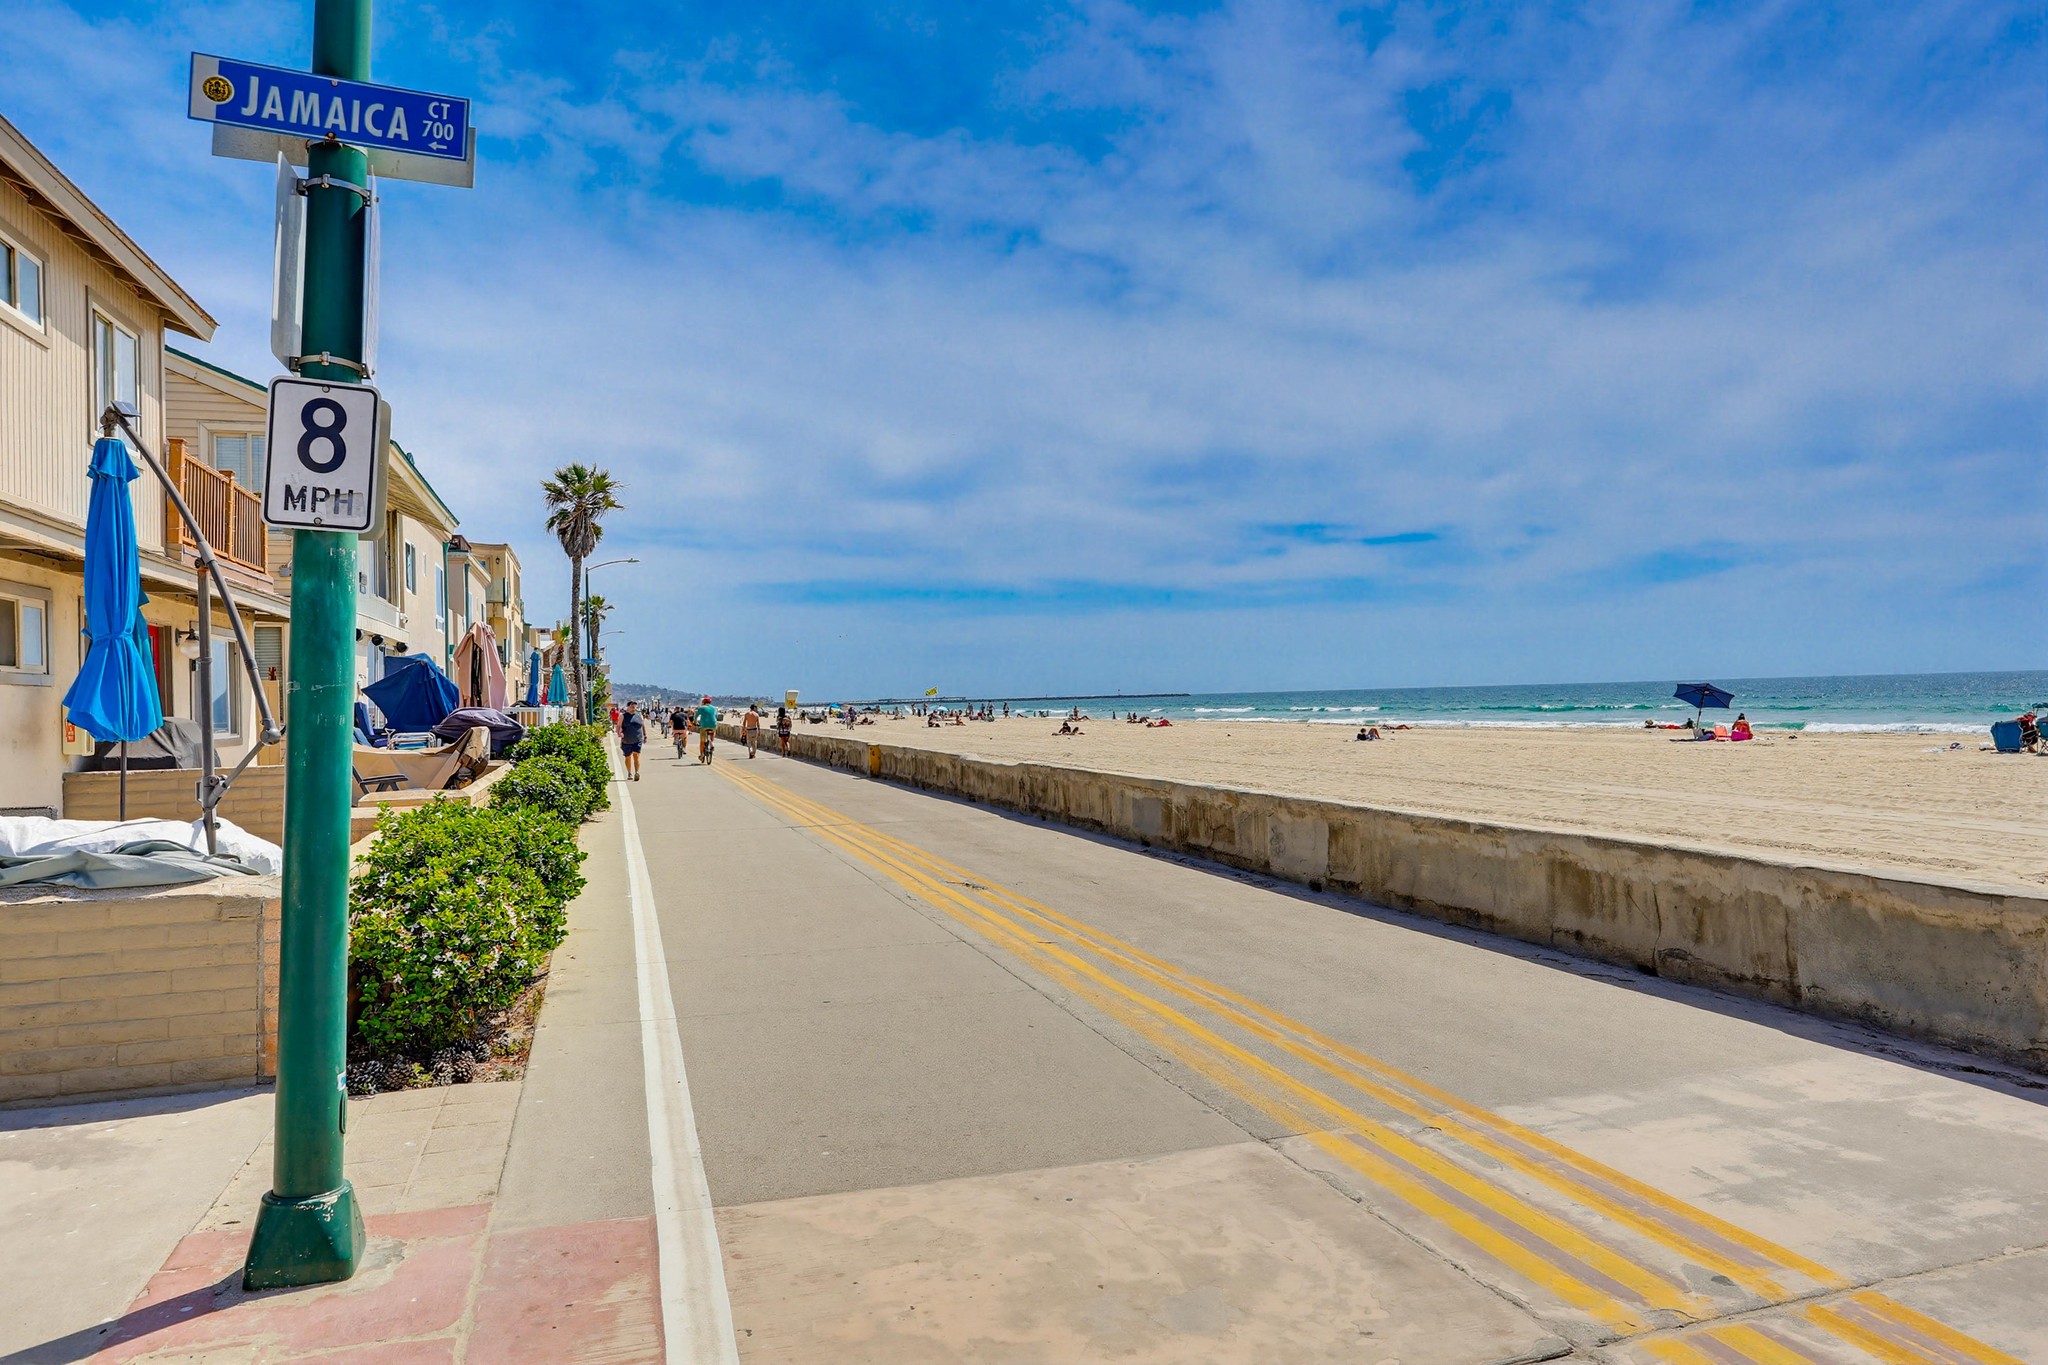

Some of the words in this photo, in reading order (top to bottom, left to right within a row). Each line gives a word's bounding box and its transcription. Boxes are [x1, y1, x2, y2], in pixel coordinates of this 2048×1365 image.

[241, 76, 409, 142] JAMAICA
[428, 101, 451, 120] CT
[421, 120, 454, 141] 700
[297, 397, 348, 474] 8
[283, 484, 354, 516] MPH
